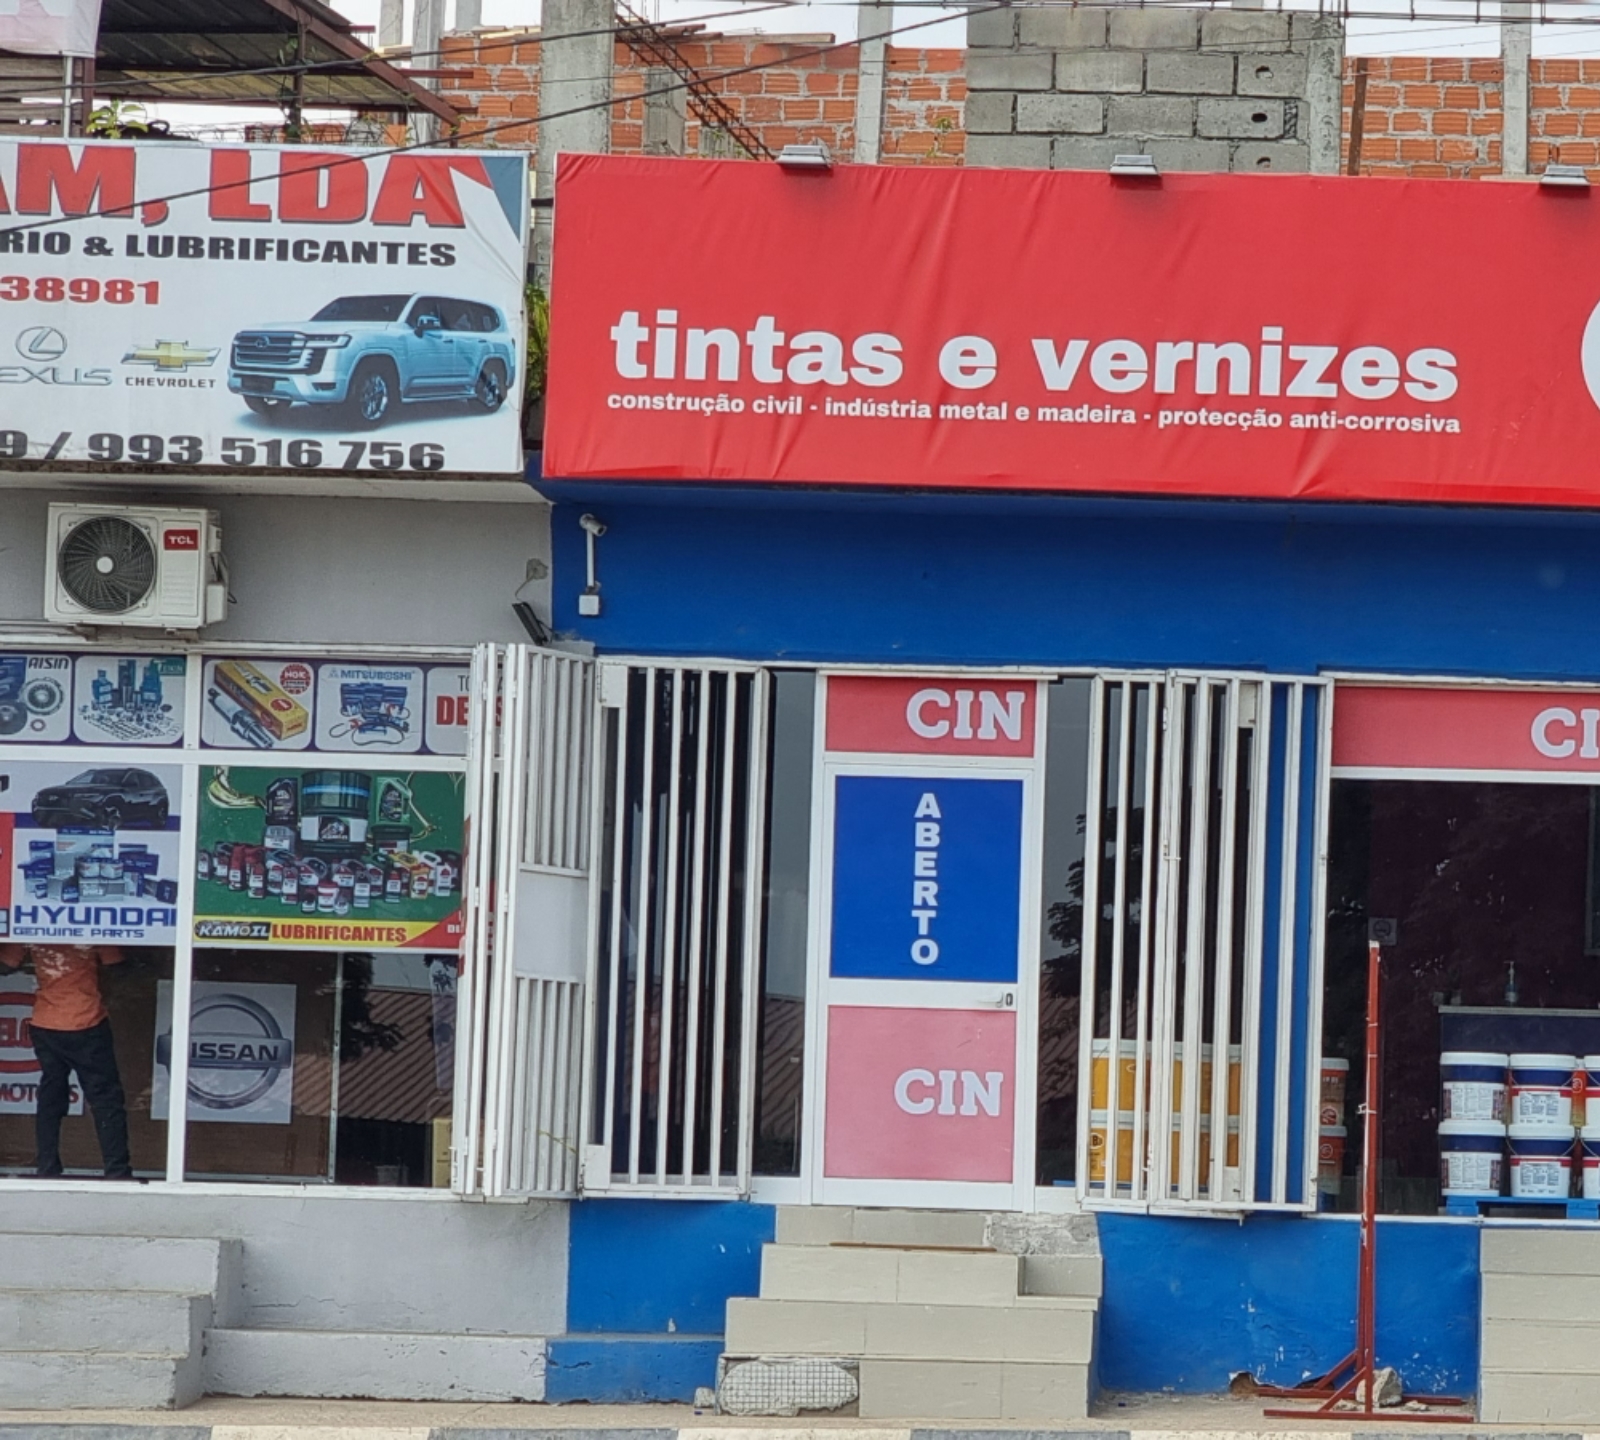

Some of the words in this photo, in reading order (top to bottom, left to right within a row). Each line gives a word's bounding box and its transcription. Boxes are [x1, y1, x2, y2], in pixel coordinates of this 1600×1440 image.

[0, 142, 168, 227] M,
[209, 148, 466, 227] LDA
[83, 236, 114, 257] &
[125, 234, 457, 267] LUBRIFICANTES
[610, 309, 904, 387] tintas
[938, 334, 997, 389] e
[1031, 326, 1459, 402] vernizes
[125, 376, 216, 389] CHEVROLET
[607, 392, 745, 416] construção
[752, 394, 803, 415] civil
[825, 396, 931, 419] indústria
[939, 400, 1008, 421] metal
[1015, 405, 1029, 421] e
[1037, 404, 1136, 424] madeira
[1158, 408, 1283, 432] protecção
[1289, 411, 1461, 434] anti-corrosiva
[44, 431, 73, 460] /
[88, 433, 204, 465] 993
[221, 438, 324, 469] 516
[340, 441, 446, 471] 756
[167, 535, 195, 546] TCL
[28, 657, 70, 670] AISIN
[340, 669, 412, 681] MITSUBOSHI
[906, 688, 1025, 741] CIN
[910, 792, 941, 966] ABERTO
[13, 926, 85, 938] GENUINE
[91, 928, 145, 939] PARTS
[198, 924, 270, 937] KAMOIL
[271, 923, 407, 943] LUBRIFICANTES
[191, 1042, 279, 1061] ISSAN
[894, 1068, 1003, 1117] CIN
